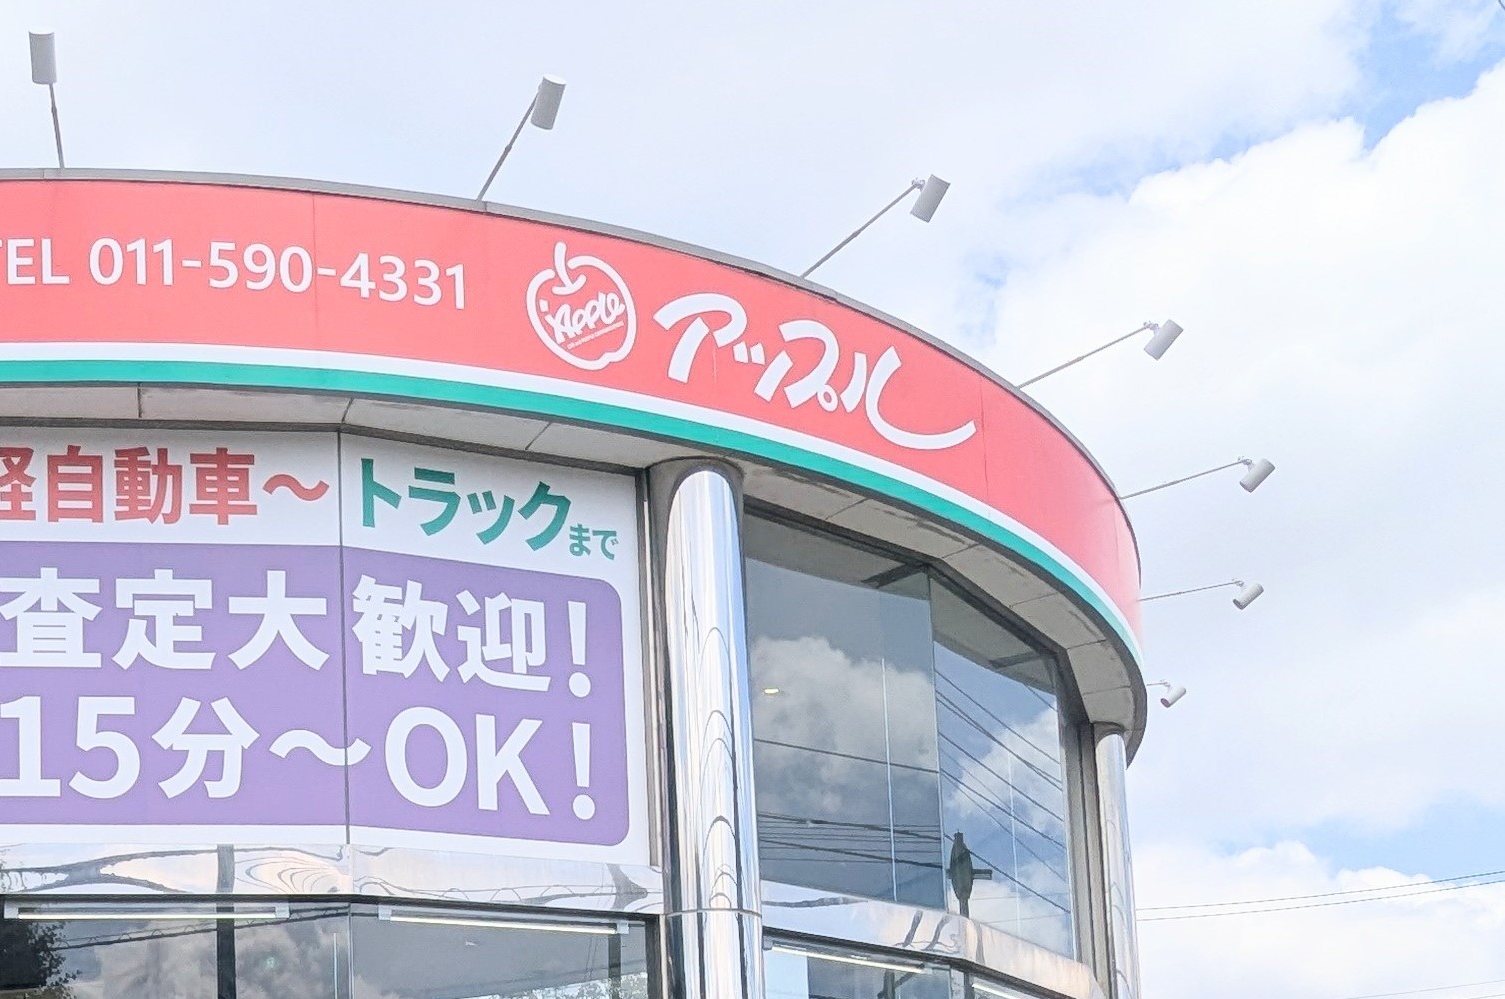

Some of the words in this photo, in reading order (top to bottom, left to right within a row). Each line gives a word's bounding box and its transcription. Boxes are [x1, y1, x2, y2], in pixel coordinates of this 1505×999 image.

[89, 236, 467, 311] 011-590-4331
[652, 291, 978, 452] アップル
